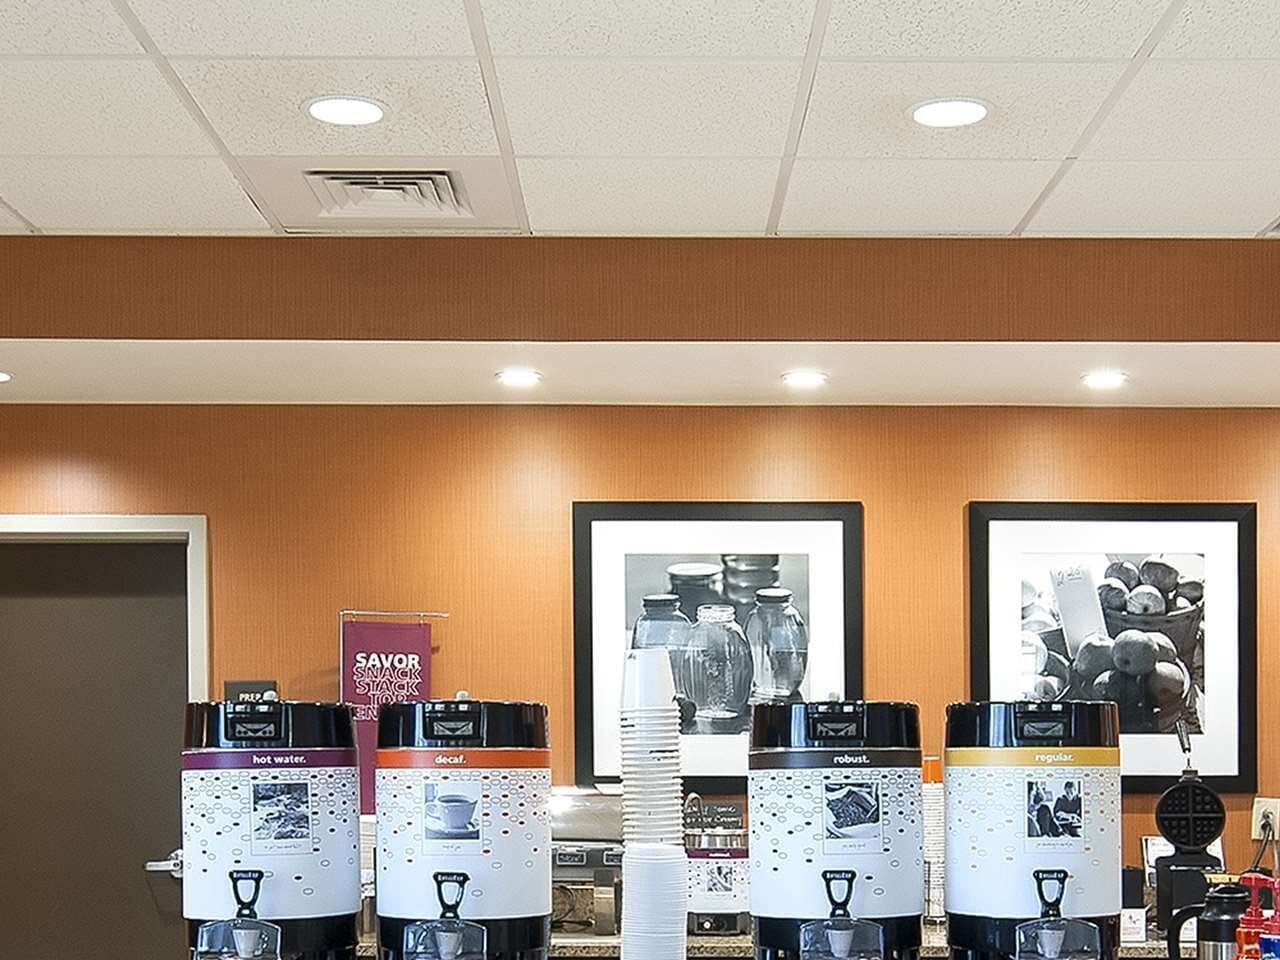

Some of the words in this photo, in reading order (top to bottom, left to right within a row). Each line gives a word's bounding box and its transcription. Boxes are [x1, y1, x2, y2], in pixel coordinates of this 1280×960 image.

[356, 653, 420, 668] SAVOR
[353, 666, 422, 681] SNACK
[356, 679, 420, 695] STACK
[252, 754, 272, 764] hot
